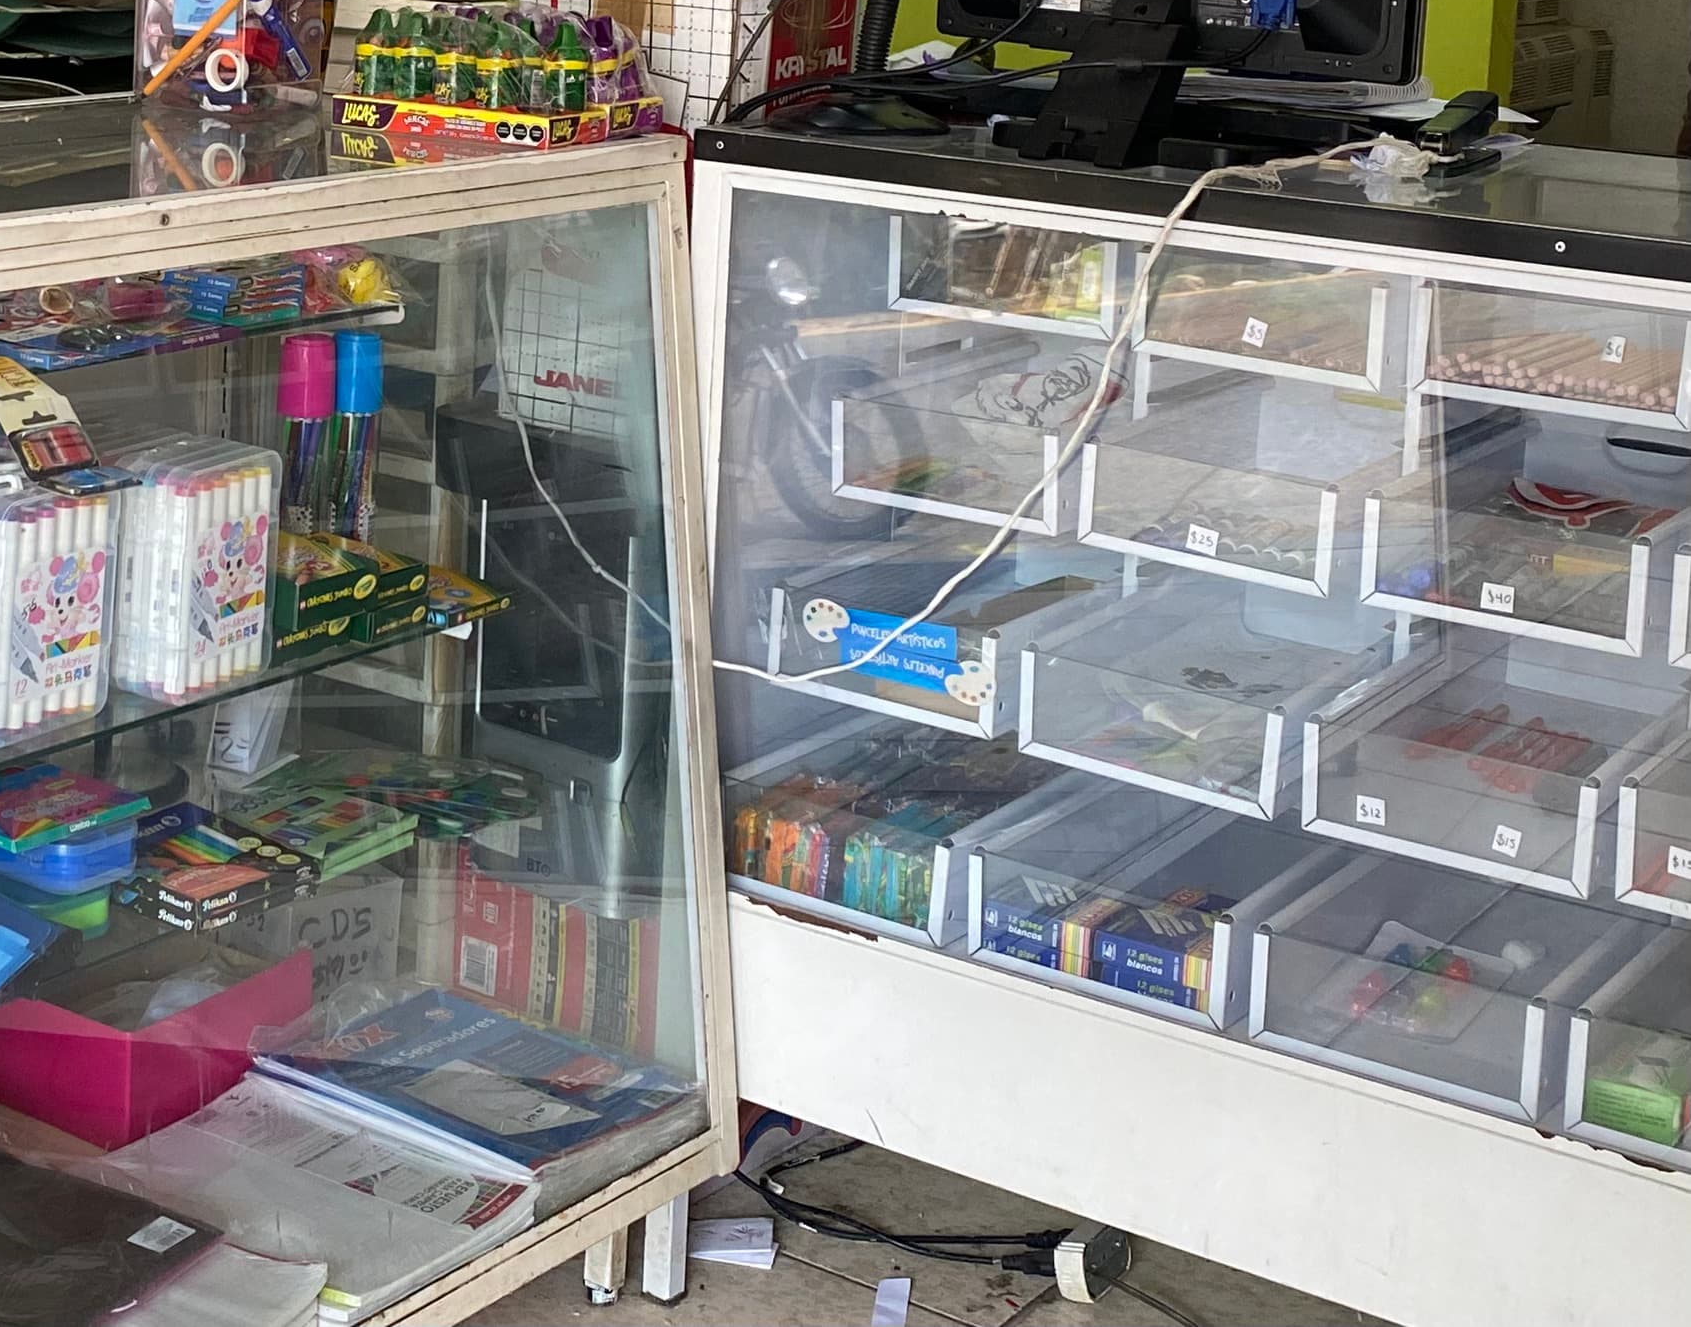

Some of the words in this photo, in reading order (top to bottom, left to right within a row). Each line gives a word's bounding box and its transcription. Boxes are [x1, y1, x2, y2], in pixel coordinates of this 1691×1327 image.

[774, 46, 848, 81] KRSTAL
[342, 102, 380, 127] LUCAS
[534, 369, 625, 402] JANE
[1359, 803, 1382, 819] $12
[1008, 924, 1043, 942] blancos
[1019, 917, 1044, 932] gises
[1126, 948, 1138, 959] 12
[1139, 951, 1164, 966] gises
[1126, 959, 1163, 976] blancos
[398, 1014, 498, 1062] Separadores
[420, 1179, 475, 1214] REPUESTO
